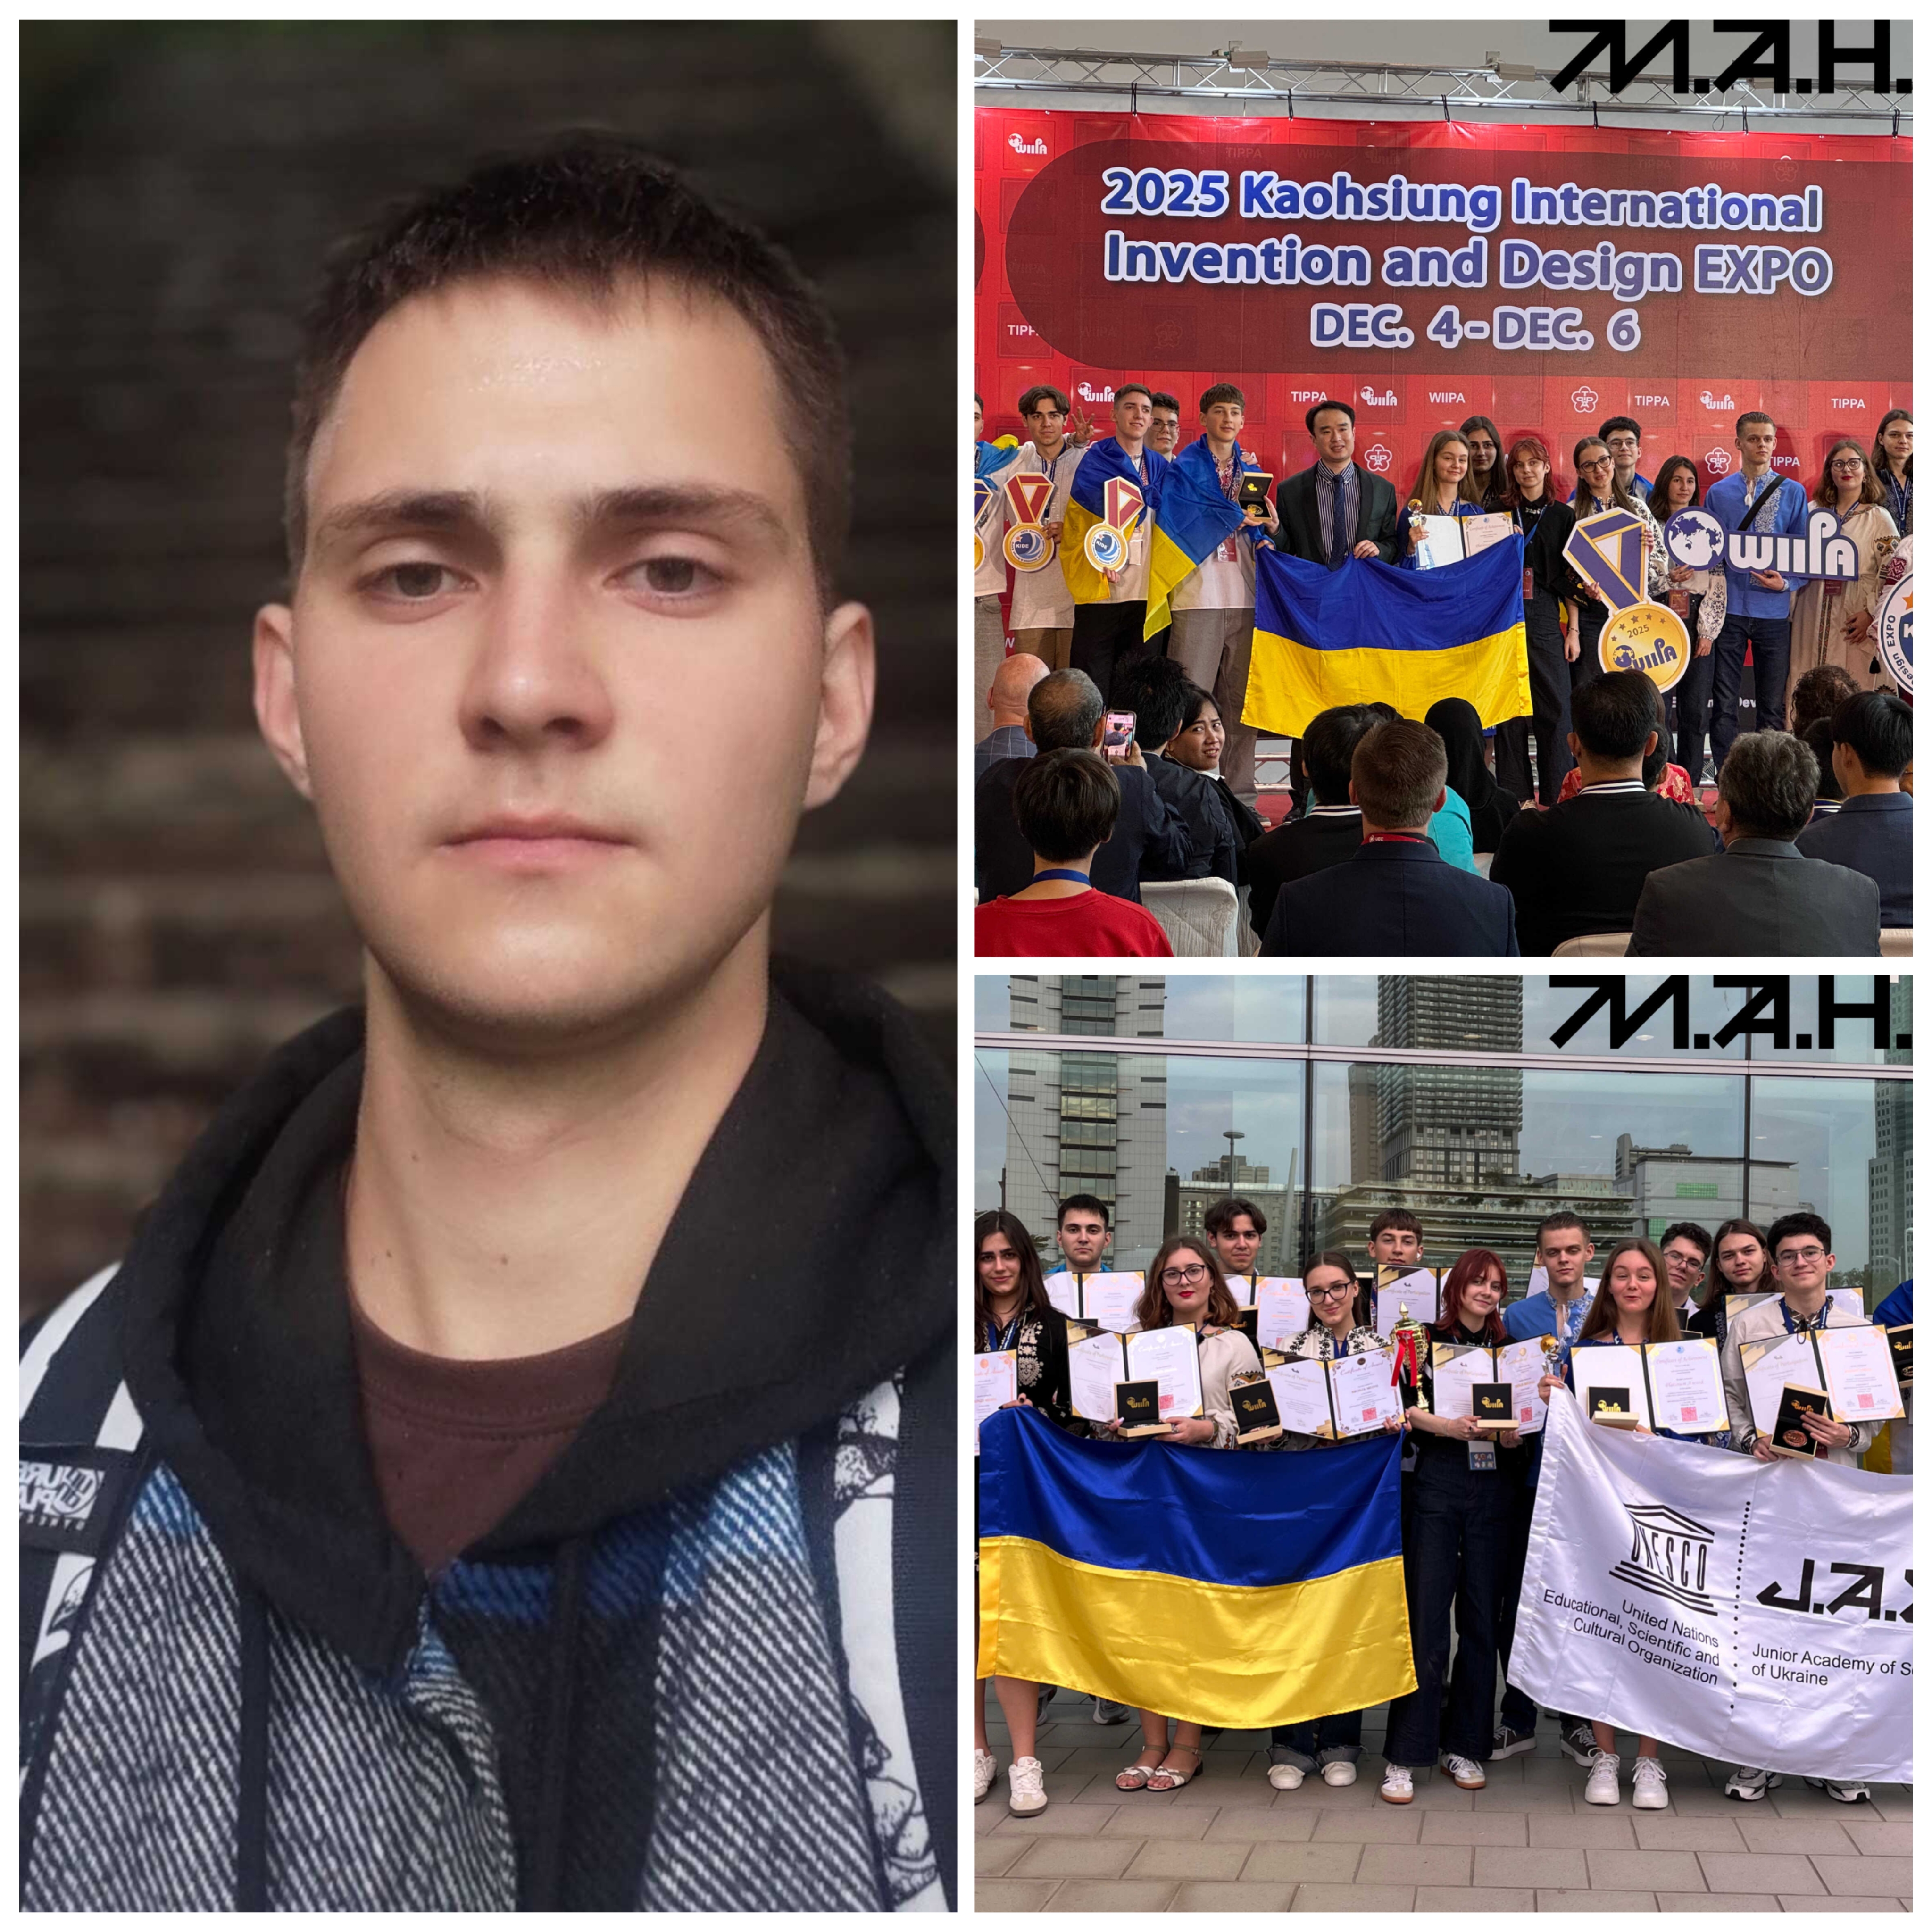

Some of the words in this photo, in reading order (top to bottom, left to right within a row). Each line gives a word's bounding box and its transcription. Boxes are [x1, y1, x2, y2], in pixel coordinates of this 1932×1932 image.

[1102, 167, 1229, 216] 2025
[1240, 171, 1501, 233] Kaohsiung
[1511, 177, 1823, 232] International
[1104, 230, 1371, 286] Invention
[1382, 236, 1488, 288] and
[1499, 238, 1682, 301] Design
[1694, 244, 1833, 295] EXPO
[1007, 325, 1039, 336] TIP
[1310, 302, 1414, 348] DEC.
[1606, 308, 1641, 352] 6
[1291, 391, 1328, 402] TIPPA
[1429, 392, 1466, 404] WIIPA
[1634, 395, 1670, 407] TIPPA
[1831, 398, 1865, 409] TIPPA
[1769, 456, 1800, 467] TIPPA
[1096, 541, 1108, 550] KIDE
[1627, 625, 1650, 638] 2025
[1886, 615, 1896, 647] EXPO
[1892, 652, 1913, 685] esign
[1631, 1518, 1707, 1591] UNESCO
[1543, 1589, 1623, 1629] Educational,
[1628, 1621, 1691, 1657] Scientific
[1695, 1649, 1720, 1666] and
[1622, 1599, 1669, 1631] United
[1672, 1621, 1719, 1647] Nations
[1574, 1617, 1625, 1645] Cultural
[1627, 1640, 1718, 1685] Organization
[1752, 1643, 1798, 1662] Junior
[1801, 1650, 1875, 1675] Academy
[1880, 1661, 1897, 1674] of
[1900, 1662, 1913, 1676] S
[1752, 1663, 1766, 1677] of
[1770, 1665, 1828, 1686] Ukraine
